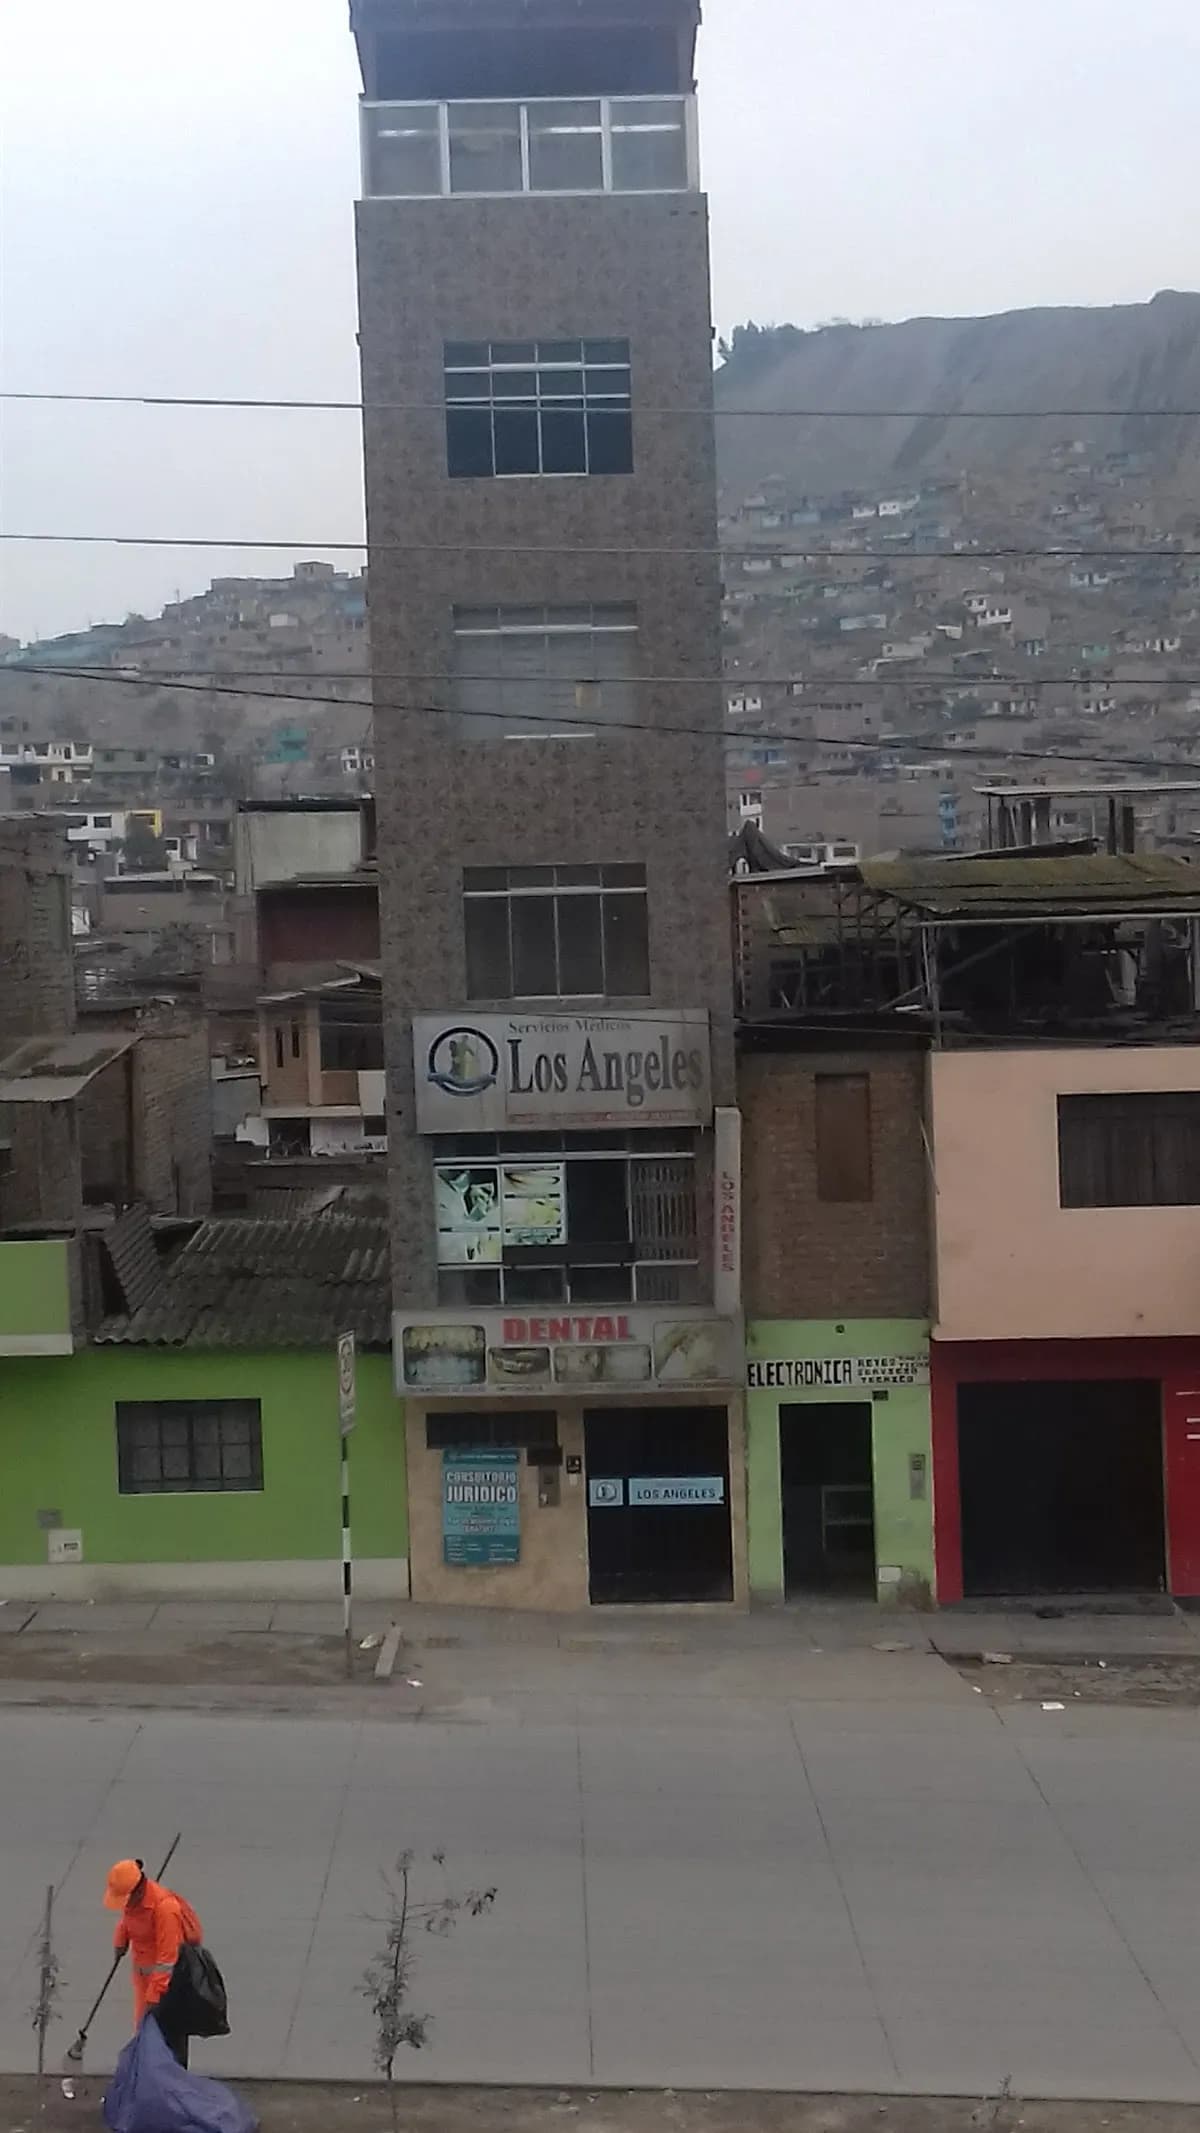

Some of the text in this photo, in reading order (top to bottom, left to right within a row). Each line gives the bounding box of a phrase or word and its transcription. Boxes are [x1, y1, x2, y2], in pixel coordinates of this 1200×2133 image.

[508, 1021, 569, 1034] Servicios
[507, 1034, 703, 1107] Los Angeles
[721, 1171, 736, 1272] LOS ANGELES
[502, 1315, 634, 1343] DENTAL
[747, 1360, 852, 1387] ELECTRONICA
[446, 1486, 517, 1503] JURIDICO
[637, 1488, 716, 1499] LOS ANGELES
